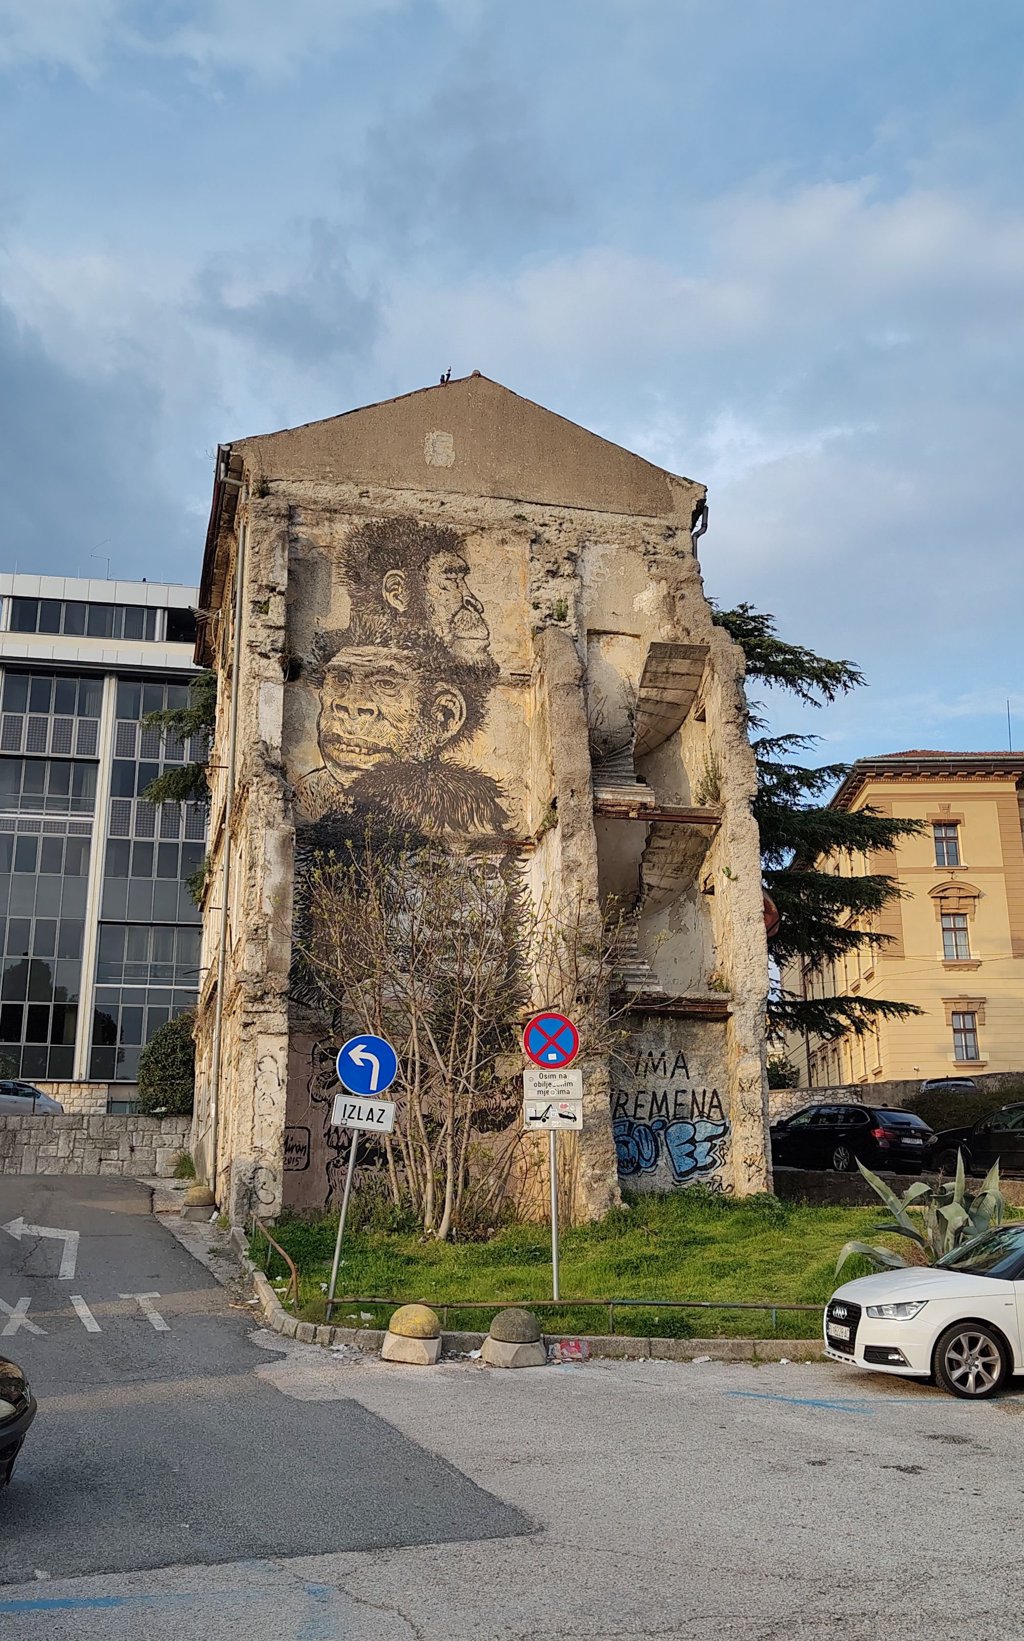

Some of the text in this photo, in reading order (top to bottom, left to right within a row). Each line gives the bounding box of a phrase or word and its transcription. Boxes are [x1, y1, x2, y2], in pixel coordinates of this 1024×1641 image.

[538, 1072, 557, 1080] Osim
[533, 1081, 574, 1089] obiljeim
[536, 1089, 571, 1097] mjeima
[342, 1103, 386, 1124] IZLAZ
[283, 1156, 303, 1167] 2015
